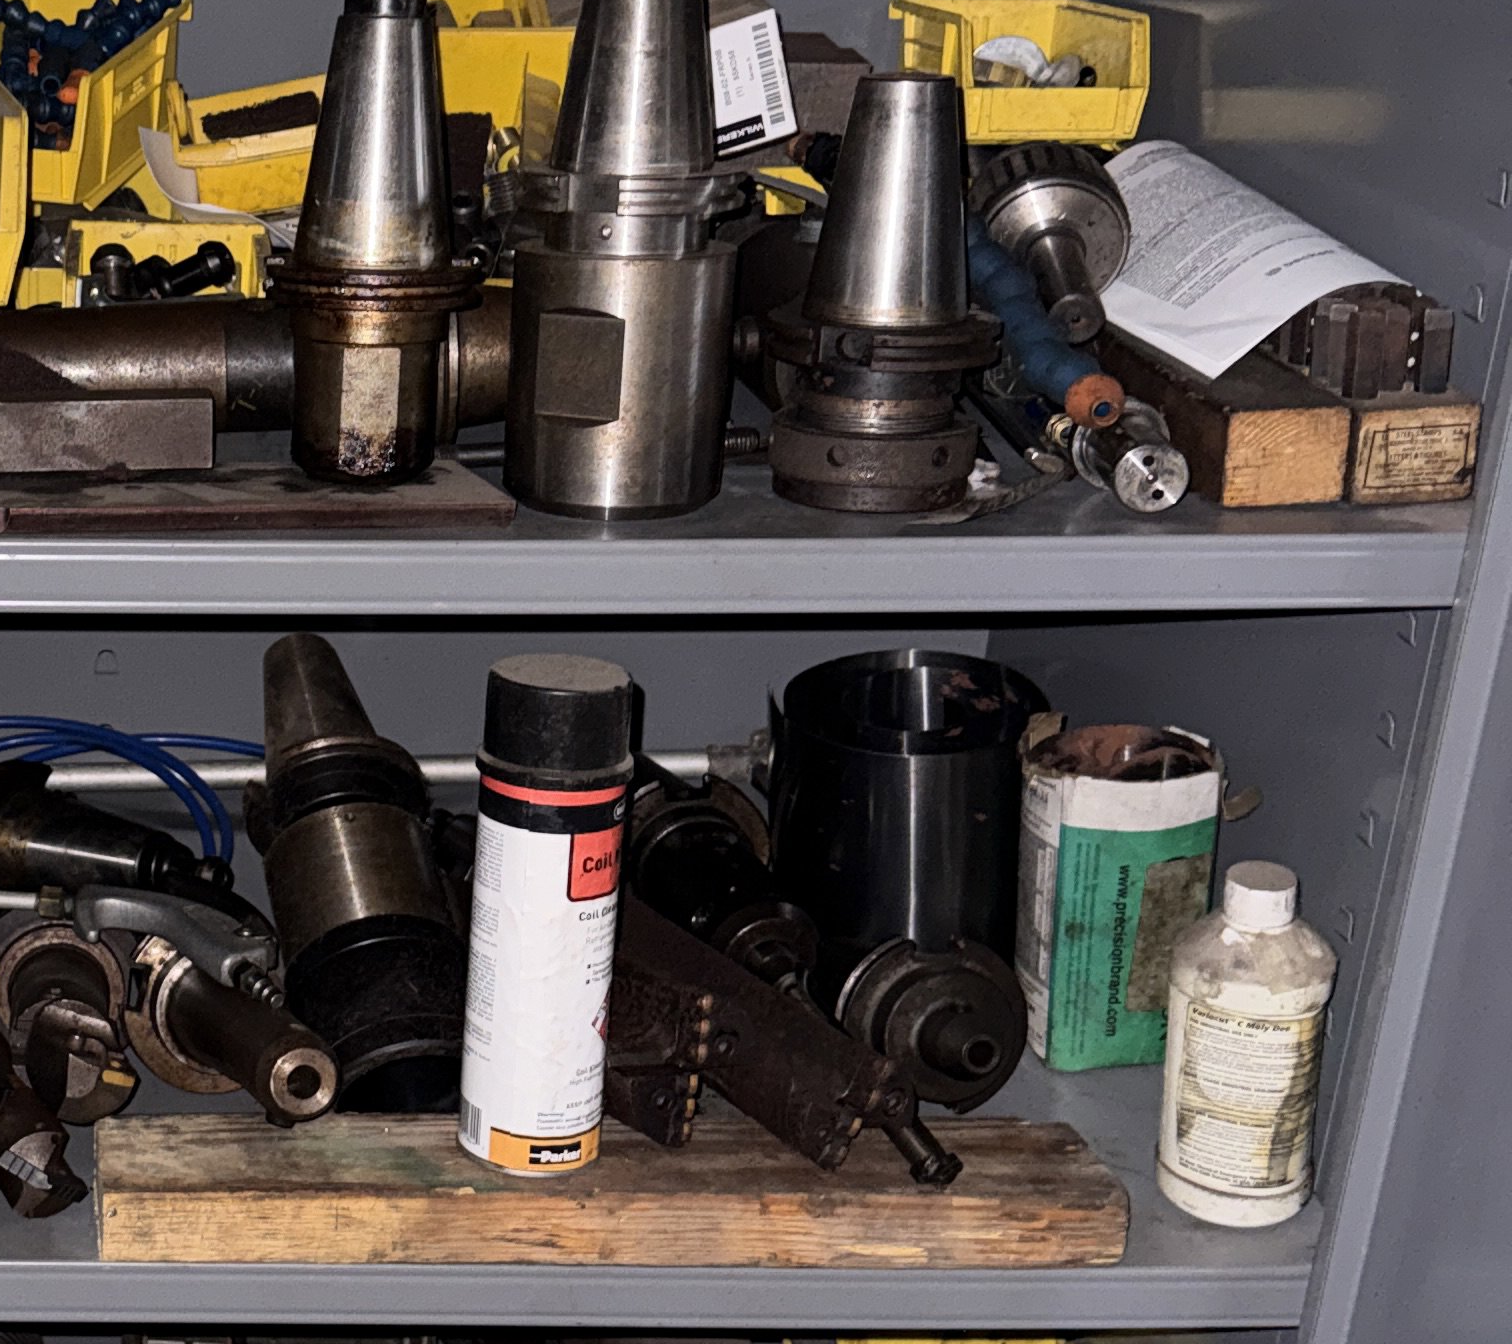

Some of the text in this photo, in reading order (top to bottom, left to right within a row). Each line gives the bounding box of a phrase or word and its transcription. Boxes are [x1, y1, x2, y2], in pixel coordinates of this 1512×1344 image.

[582, 850, 613, 874] Coil
[578, 908, 600, 922] Coil
[1105, 864, 1130, 1038] www.precisionbrand.com
[1246, 1021, 1271, 1032] Moly
[540, 1149, 581, 1163] Parker
